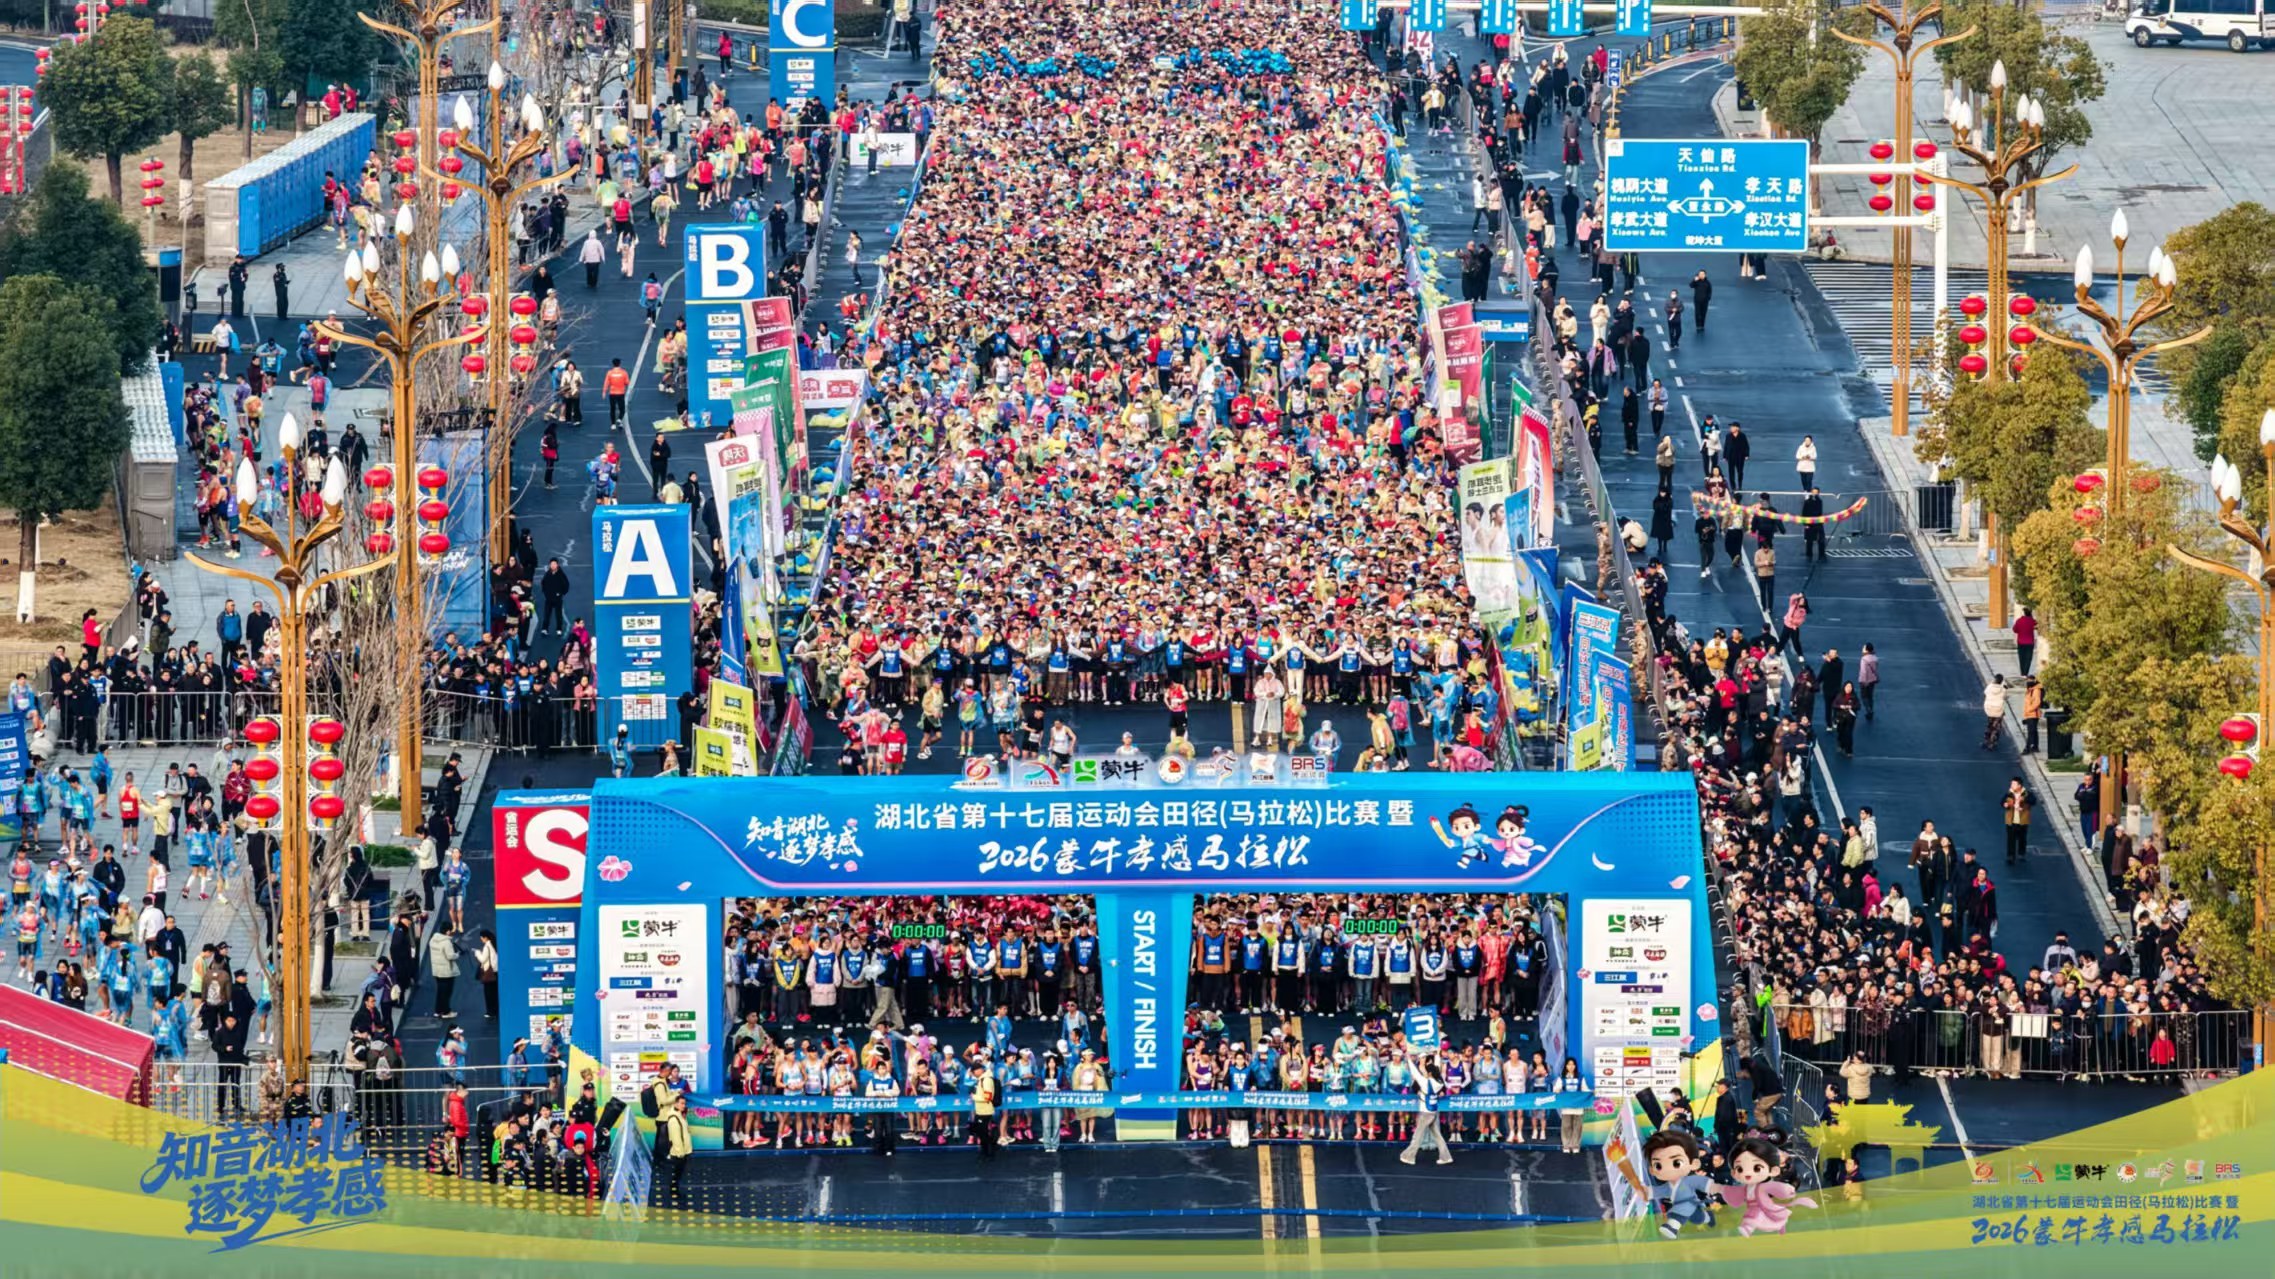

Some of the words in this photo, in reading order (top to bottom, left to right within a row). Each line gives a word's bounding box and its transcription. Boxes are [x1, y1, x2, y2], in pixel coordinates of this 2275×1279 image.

[781, 0, 827, 47] C
[1744, 177, 1803, 195] 孝天路
[1610, 211, 1669, 228] 孝武大道
[1744, 211, 1802, 228] 孝汉大道
[700, 234, 754, 298] B
[602, 521, 613, 553] 马拉松
[603, 519, 678, 597] A
[1101, 760, 1144, 781] 蒙牛
[1291, 757, 1325, 770] BRS
[746, 813, 830, 846] 知音湖北
[875, 799, 1380, 831] 湖北省第十七届运动会田径(马拉松)比赛
[1387, 801, 1414, 827] 暨
[522, 809, 589, 900] S
[779, 830, 864, 866] 逐梦孝感
[643, 919, 678, 937] 蒙牛
[892, 924, 945, 939] 0:00:00
[1344, 919, 1398, 934] 0:00:00
[1629, 914, 1665, 933] 蒙牛
[1134, 910, 1155, 977] START
[1134, 997, 1155, 1070] FINISH
[1411, 1015, 1435, 1041] 3
